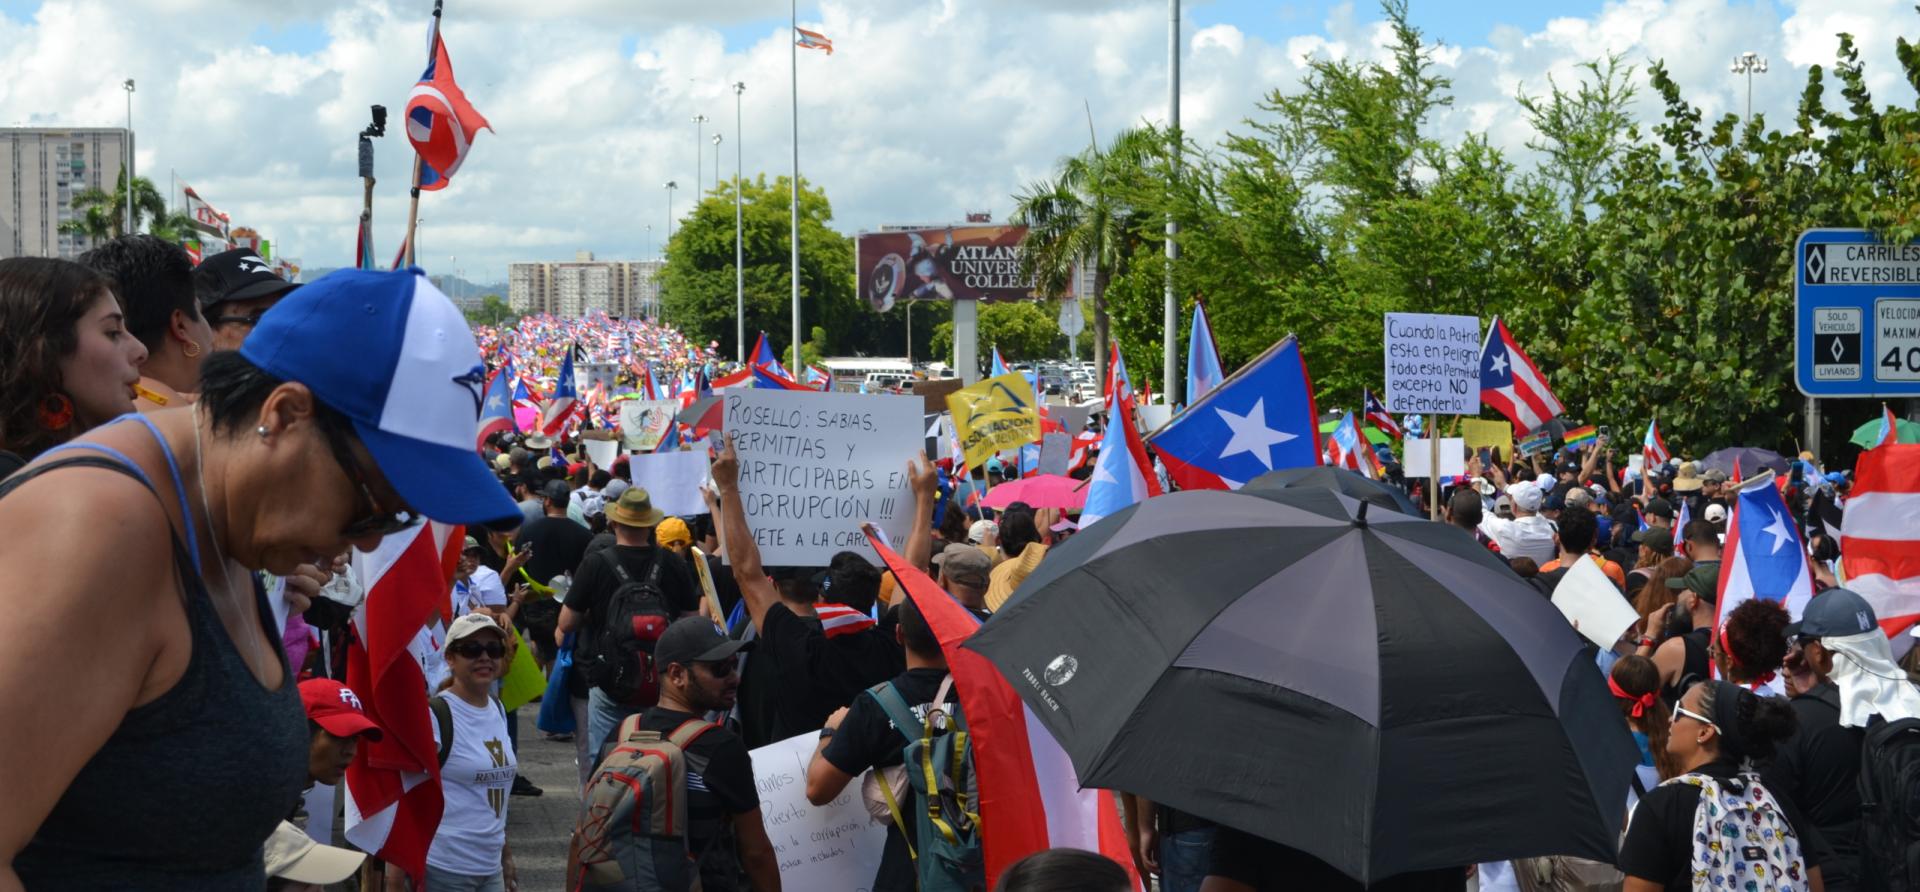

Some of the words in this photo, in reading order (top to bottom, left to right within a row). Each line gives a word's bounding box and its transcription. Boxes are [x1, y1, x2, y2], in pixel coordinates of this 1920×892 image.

[1846, 246, 1920, 262] CARRILES
[1830, 267, 1920, 282] REVERSIBL
[1827, 312, 1848, 321] SOLO
[1819, 322, 1856, 332] VEHICULOS
[1424, 345, 1440, 358] en
[1391, 360, 1418, 375] todo
[1819, 367, 1856, 376] LIVIANOS
[1392, 379, 1442, 392] excepto
[1450, 379, 1468, 394] NO
[730, 429, 826, 459] PERMITIAS
[846, 443, 856, 461] Y
[740, 459, 874, 491] ARTICIPABAS
[739, 491, 870, 520] ORRUPCIÓN
[795, 533, 804, 546] A
[812, 531, 829, 547] LA
[834, 531, 870, 547] CARC
[826, 792, 853, 809] ico
